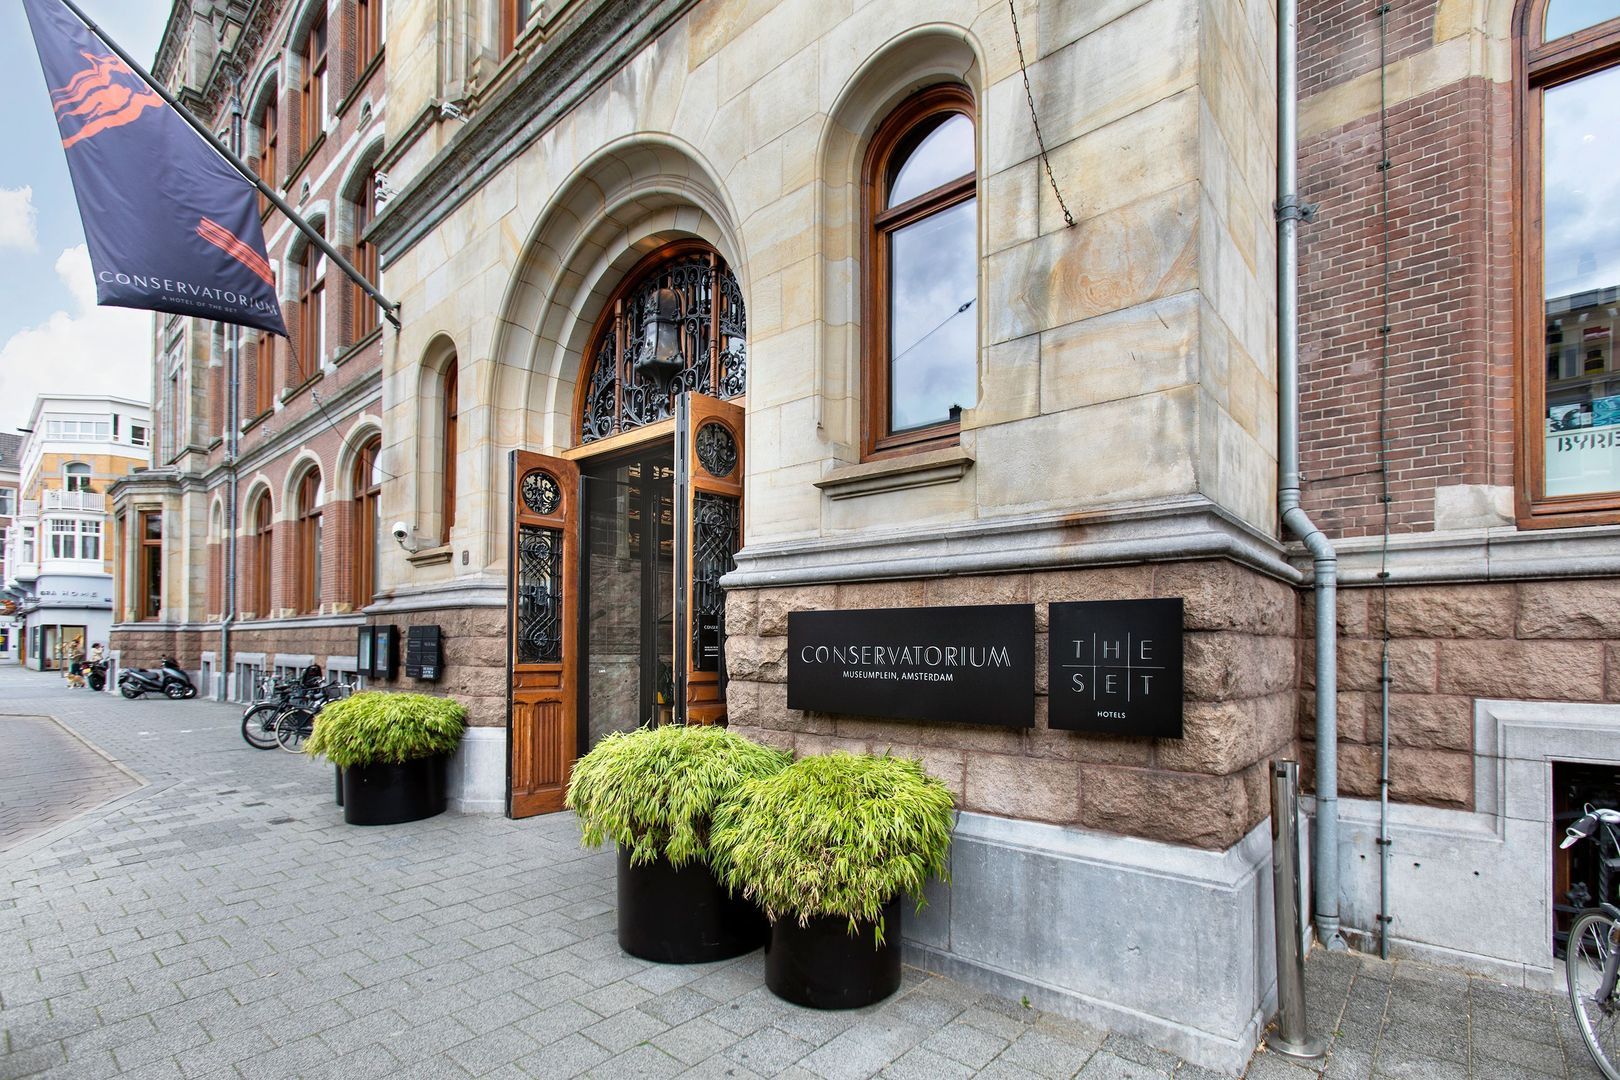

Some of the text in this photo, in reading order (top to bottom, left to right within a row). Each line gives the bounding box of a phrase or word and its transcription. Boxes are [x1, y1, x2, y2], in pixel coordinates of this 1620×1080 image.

[99, 270, 277, 316] CONSERVATORIUM
[169, 296, 194, 306] HOTEL
[801, 645, 1011, 667] CONSERVATORIUM
[1072, 640, 1153, 660] THE
[842, 670, 954, 682] MUSEUMPLEIN, AMSTERDAM
[1071, 673, 1154, 695] SET
[1097, 711, 1126, 719] HOTELS
